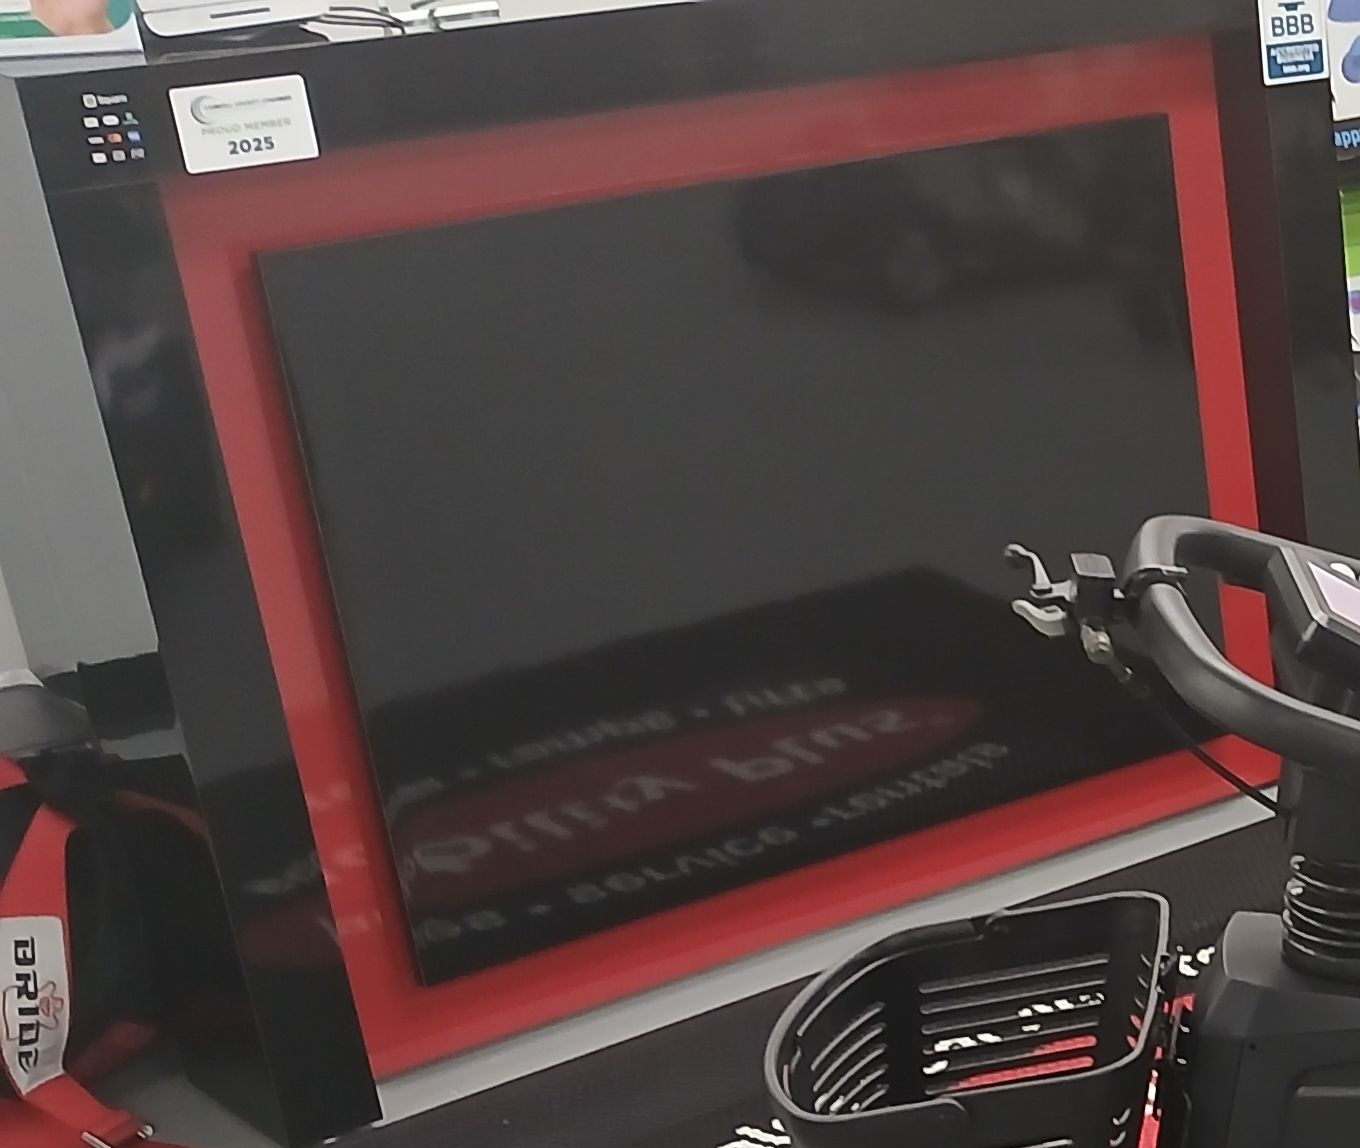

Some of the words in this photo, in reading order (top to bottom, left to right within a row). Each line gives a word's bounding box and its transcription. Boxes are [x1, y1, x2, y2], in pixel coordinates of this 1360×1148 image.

[1270, 13, 1315, 37] BBB
[227, 136, 275, 156] 2025
[14, 936, 40, 1074] BRIDE
